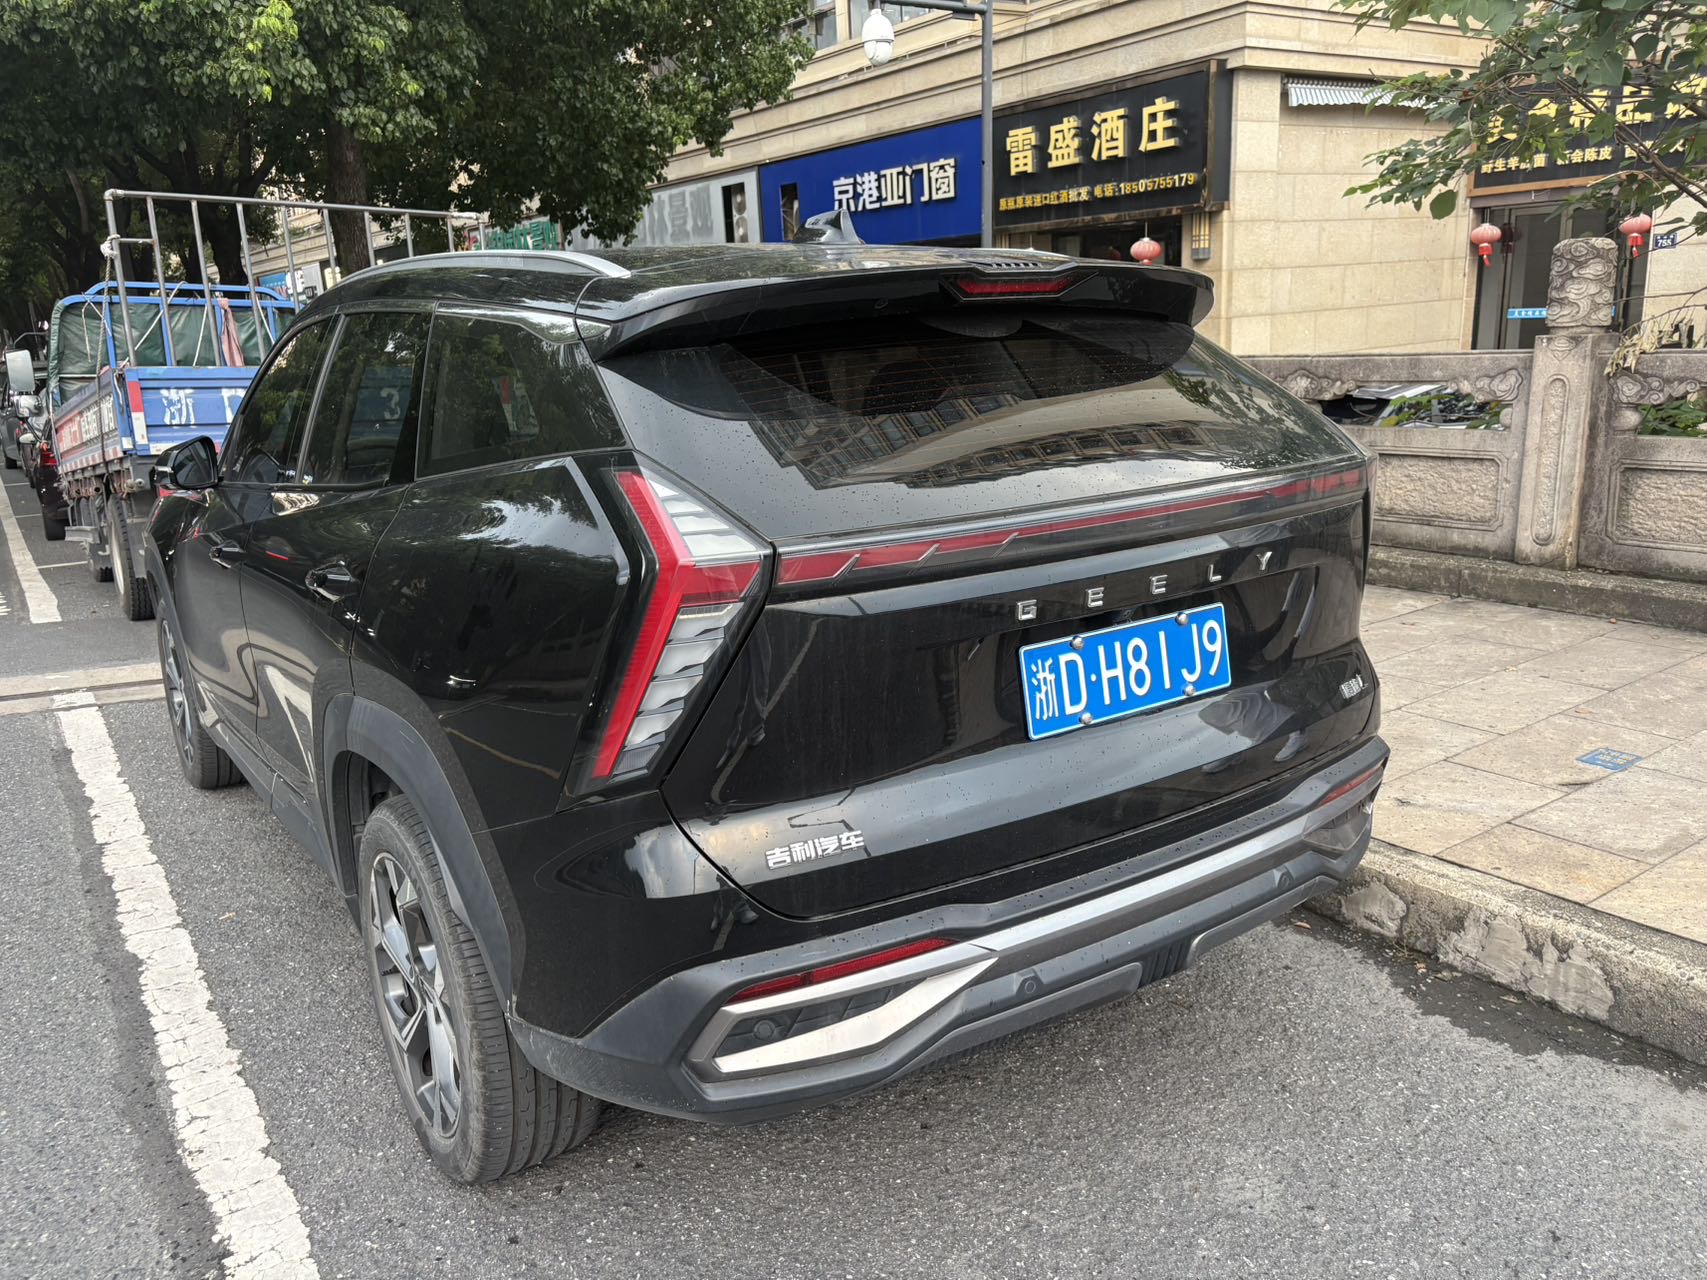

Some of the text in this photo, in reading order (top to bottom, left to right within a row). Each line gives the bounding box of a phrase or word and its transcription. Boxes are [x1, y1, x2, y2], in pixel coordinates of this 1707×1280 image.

[1005, 96, 1181, 177] 雷盛酒庄
[832, 157, 957, 213] 京港亚门窗
[1016, 551, 1273, 622] GEELY
[765, 829, 865, 870] 吉利汽车
